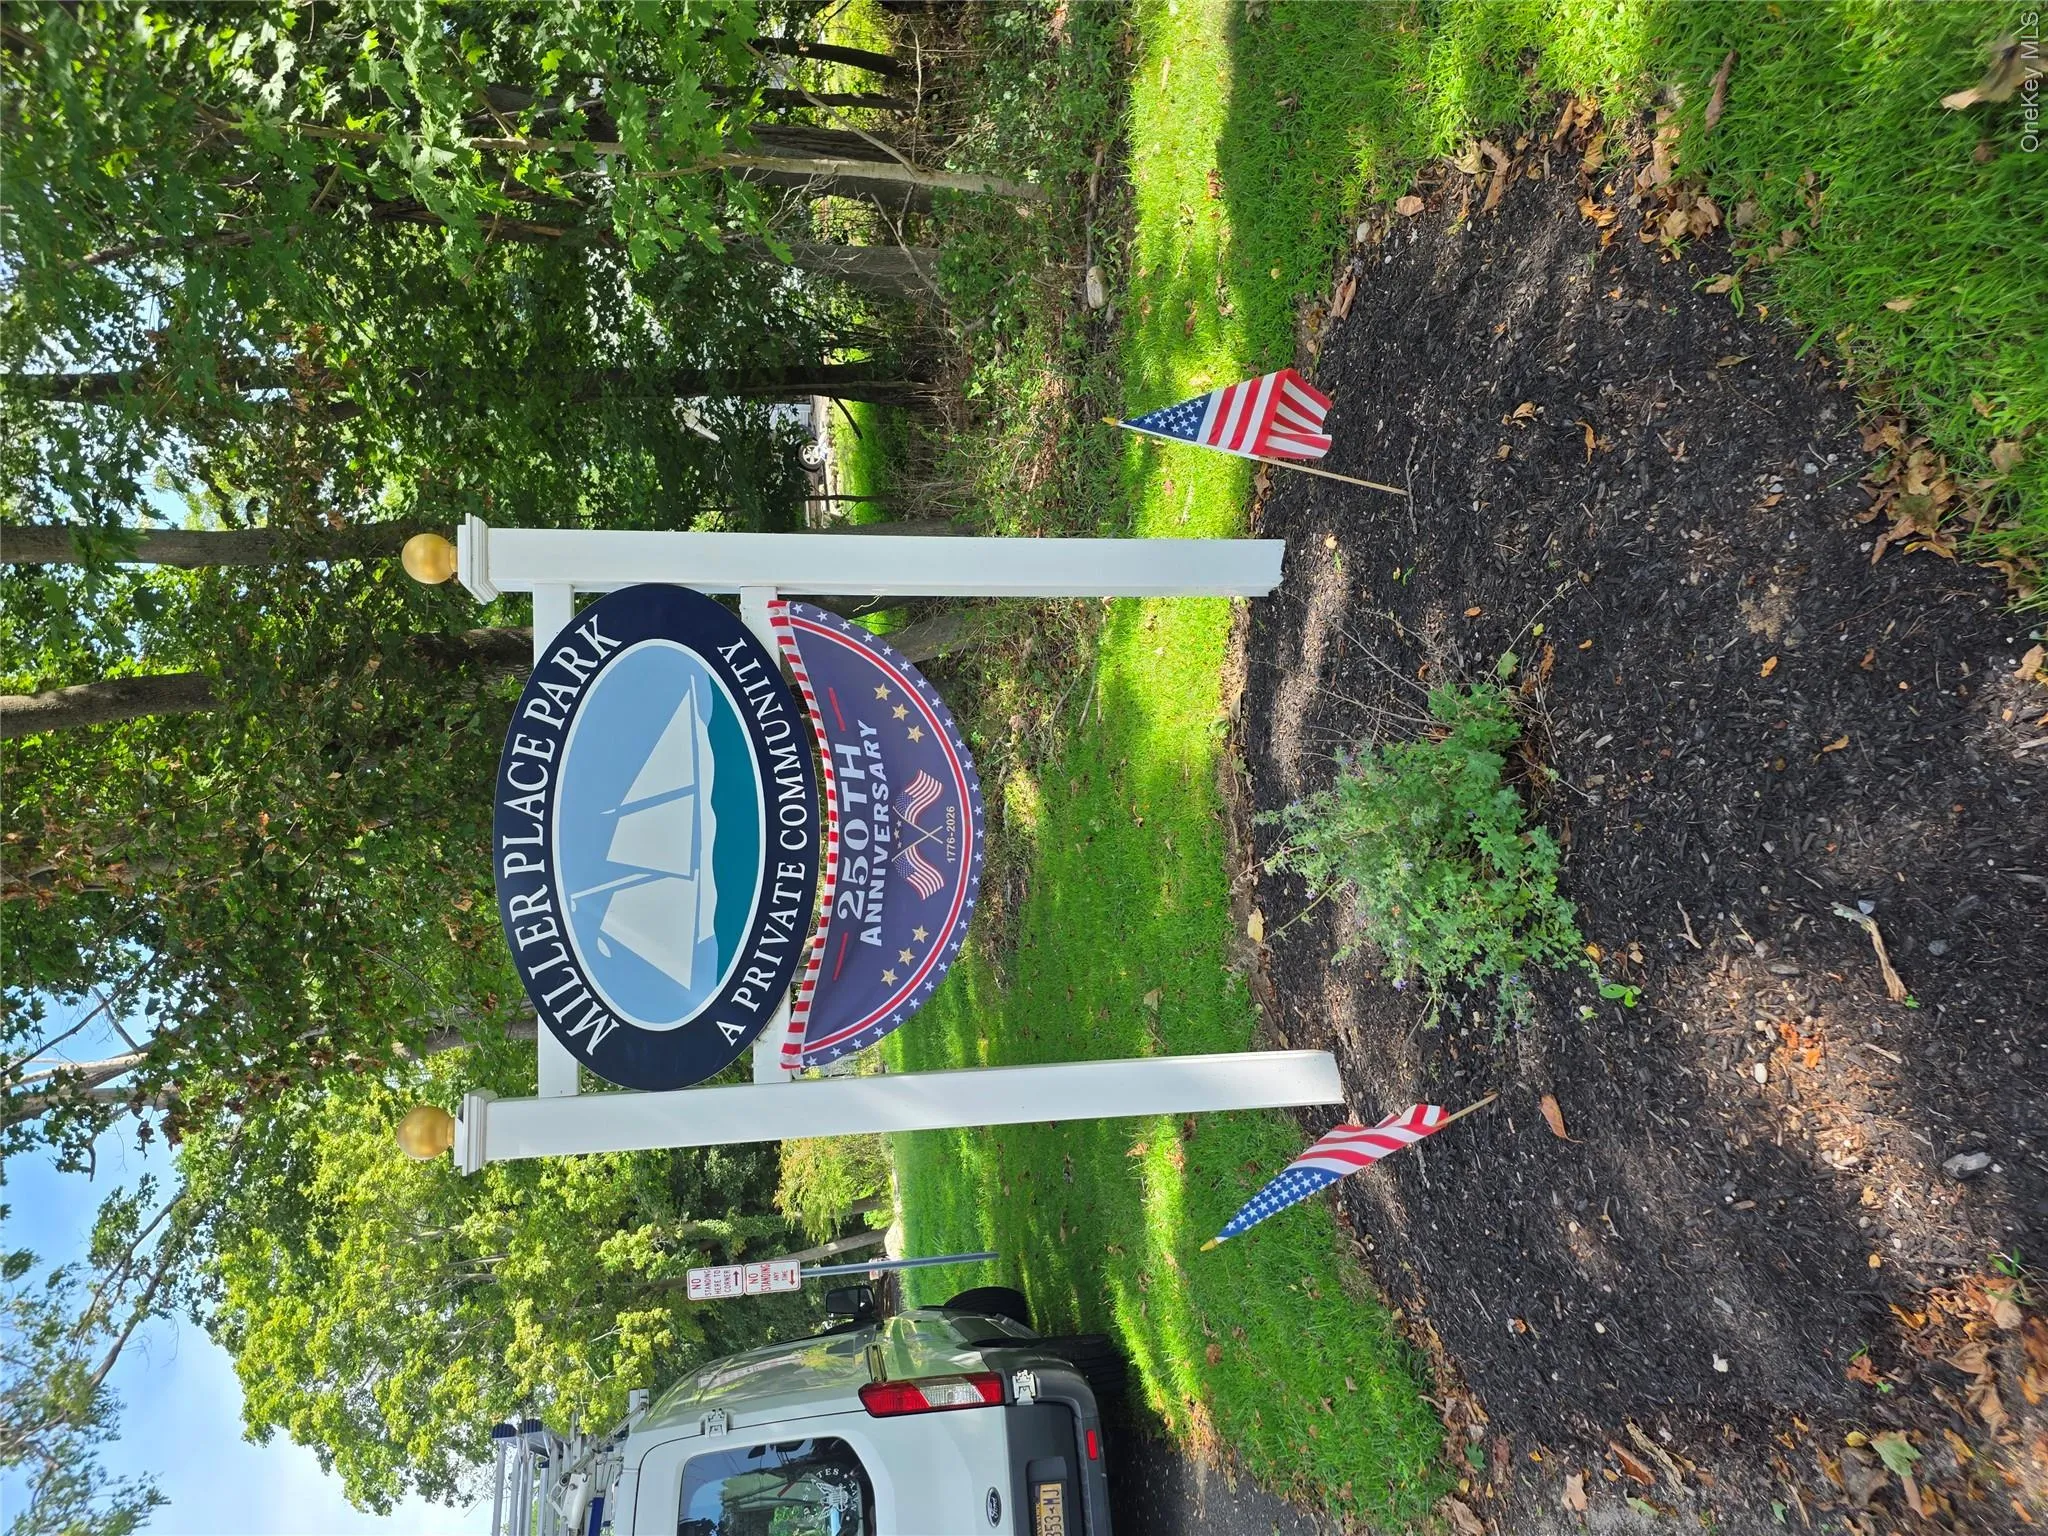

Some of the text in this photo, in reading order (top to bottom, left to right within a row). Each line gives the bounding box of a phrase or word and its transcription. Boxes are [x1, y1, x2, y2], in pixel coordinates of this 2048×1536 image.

[501, 614, 623, 1056] MILLER PLACE PARK
[715, 637, 808, 1046] A PRIVATE COMMUNITY
[835, 743, 870, 920] 250TH
[857, 719, 891, 947] ANNIVERSARY
[945, 805, 957, 864] 1776-2026
[691, 1278, 702, 1290] NO
[703, 1269, 712, 1296] STANDING
[713, 1269, 722, 1295] HERE TO
[723, 1269, 732, 1293] CORNER
[748, 1273, 759, 1285] NO
[761, 1264, 771, 1291] STANDING
[848, 1480, 859, 1512] NAVY
[988, 1497, 999, 1519] Ford
